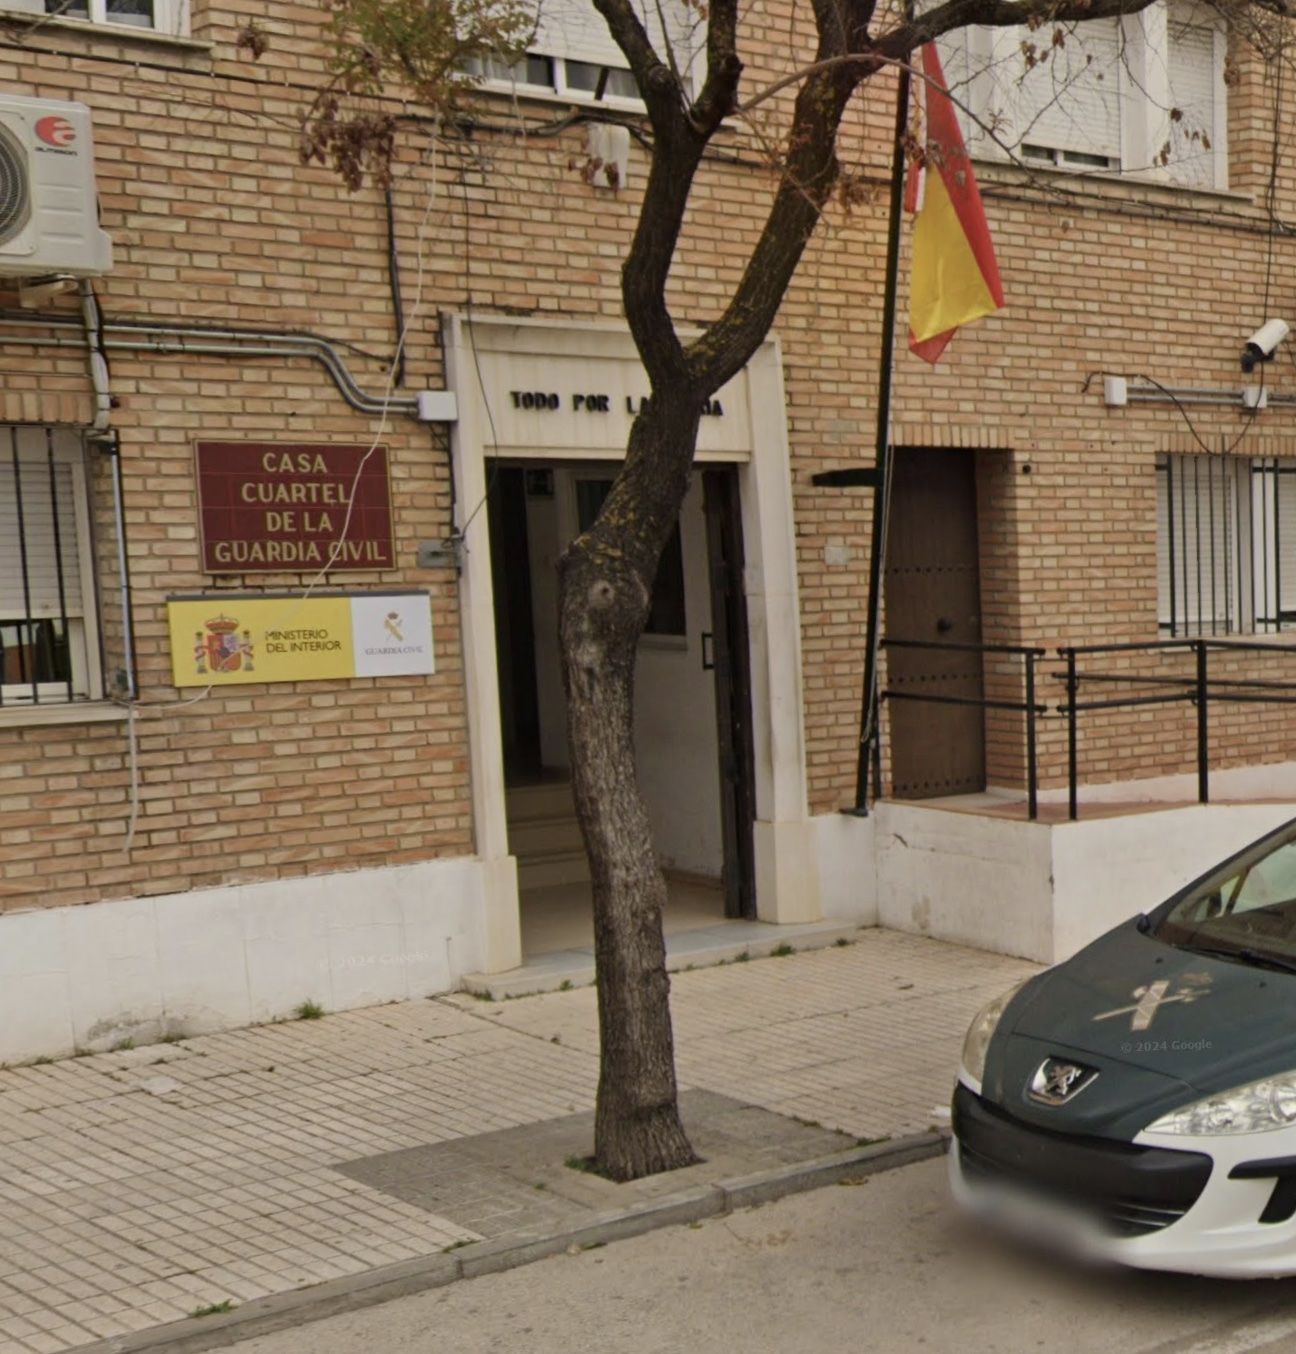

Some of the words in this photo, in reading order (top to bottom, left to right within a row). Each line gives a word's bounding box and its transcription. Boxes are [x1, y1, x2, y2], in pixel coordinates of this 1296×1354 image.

[510, 391, 560, 410] TODO
[572, 394, 609, 412] POR
[262, 452, 328, 473] CASA
[241, 483, 351, 504] CUARTEL
[266, 511, 297, 532] DE
[303, 512, 333, 532] LA
[215, 540, 322, 563] GUARDIA
[328, 541, 387, 562] CIVIL
[265, 628, 328, 641] MINISTERIO
[266, 642, 288, 653] DEL
[291, 640, 342, 652] INTERIOR
